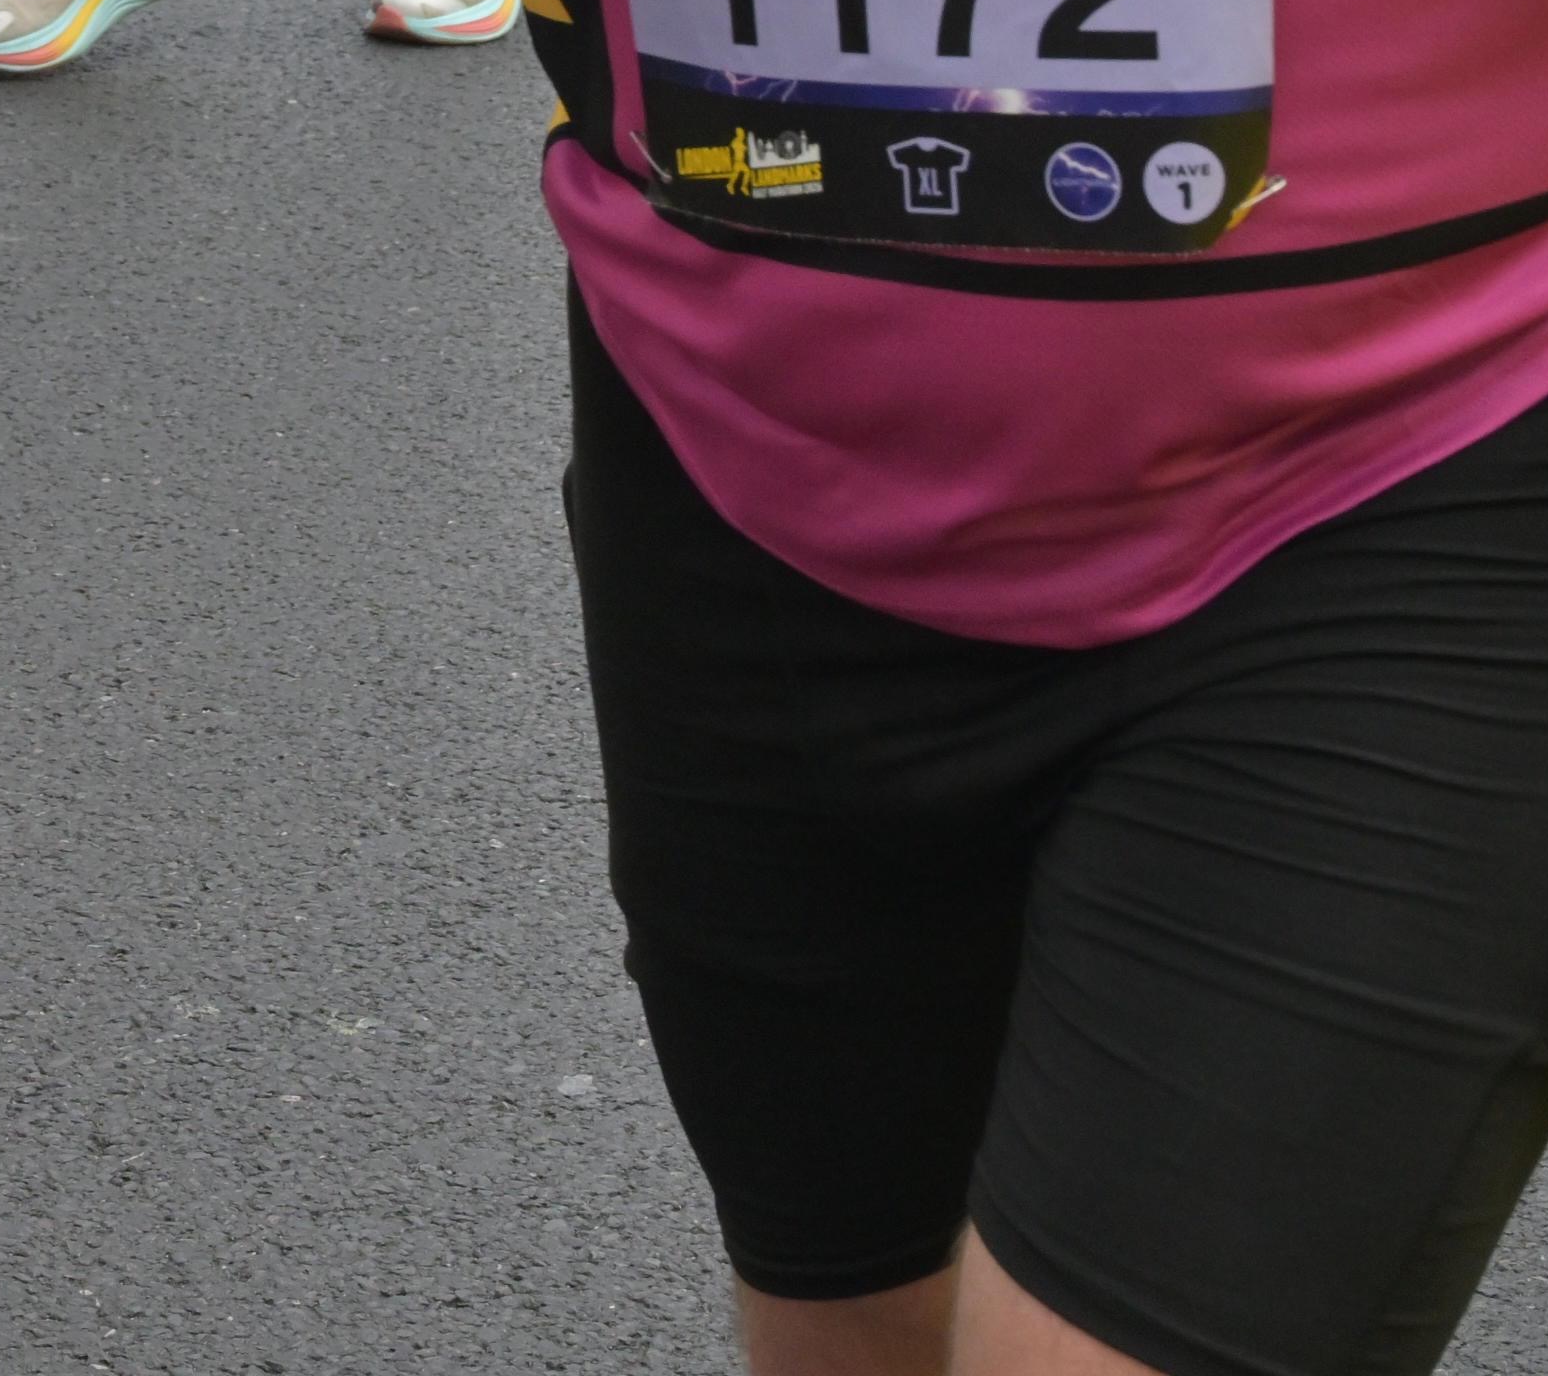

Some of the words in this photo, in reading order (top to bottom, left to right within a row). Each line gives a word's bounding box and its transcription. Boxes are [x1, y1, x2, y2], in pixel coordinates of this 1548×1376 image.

[676, 145, 733, 176] LONDON
[1157, 162, 1212, 178] WAVE
[917, 167, 943, 197] XL
[1177, 181, 1193, 211] 1
